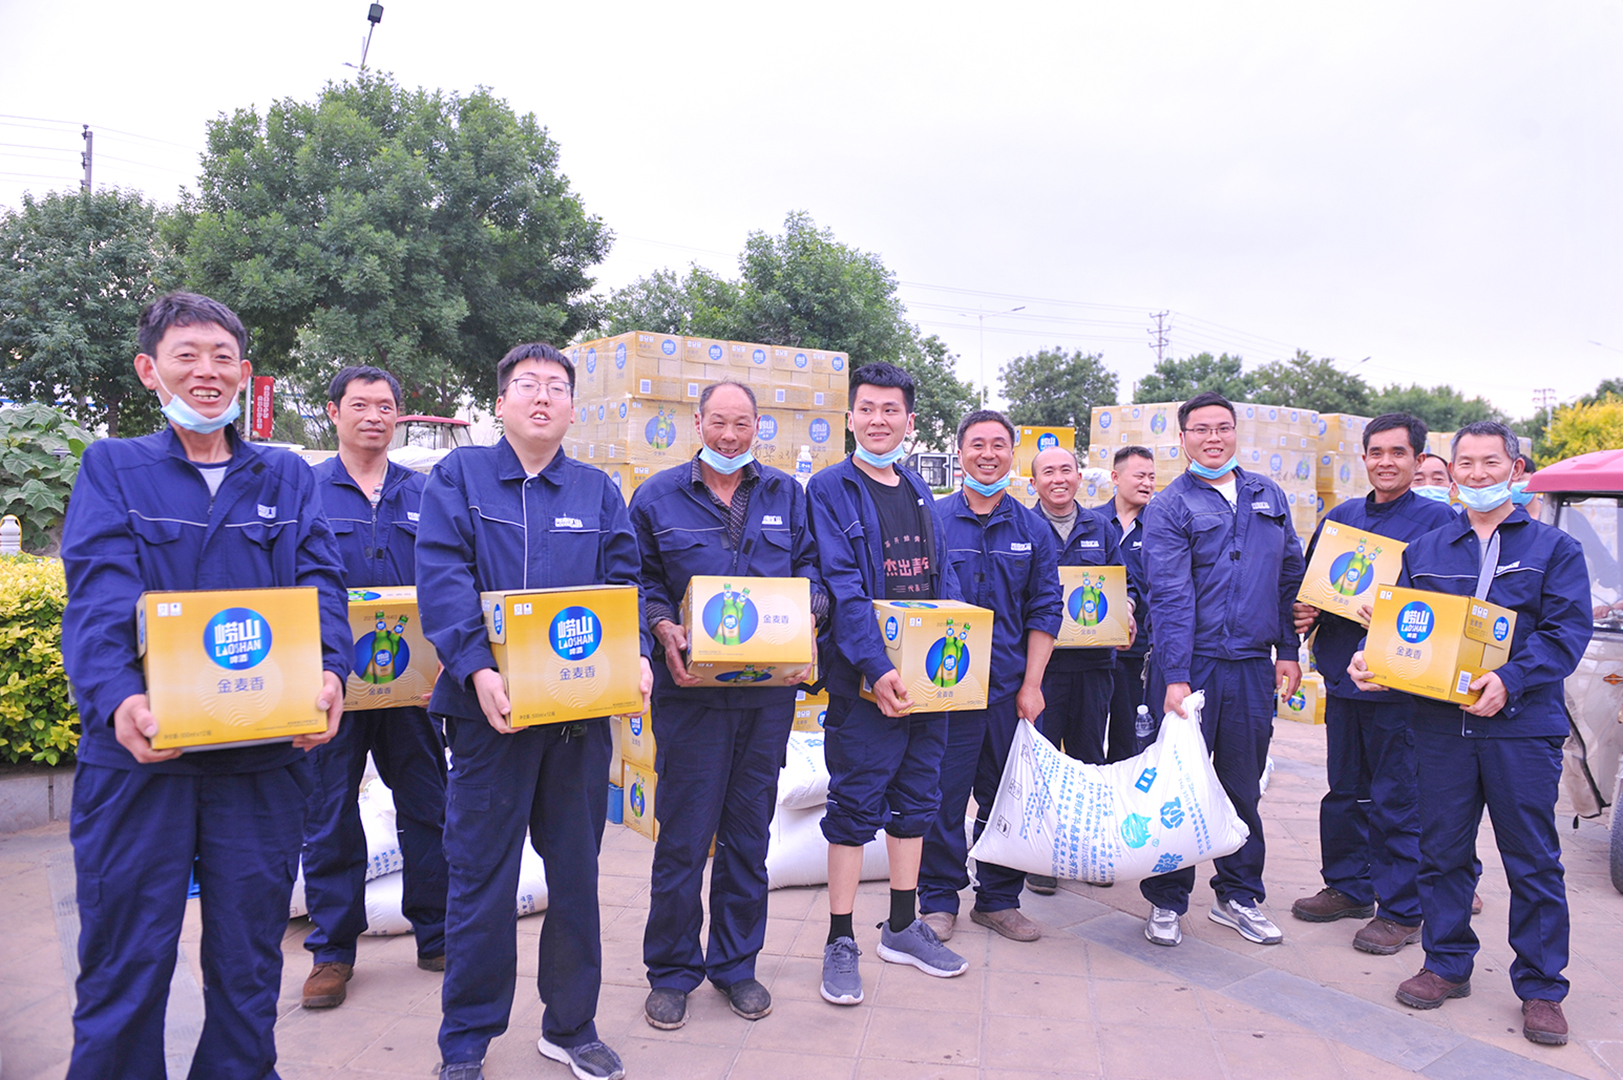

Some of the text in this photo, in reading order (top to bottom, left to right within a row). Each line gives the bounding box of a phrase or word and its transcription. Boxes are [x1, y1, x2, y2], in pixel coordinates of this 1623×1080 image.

[763, 614, 789, 624] 金麦香
[1402, 610, 1430, 625] 崂山
[214, 619, 261, 645] 崂山
[558, 616, 593, 639] 崂山
[215, 638, 262, 657] LAOSHAN
[558, 634, 594, 649] LAOSHAN
[1396, 645, 1422, 660] 金麦香
[559, 665, 596, 681] 金麦香
[217, 676, 264, 694] 金麦香
